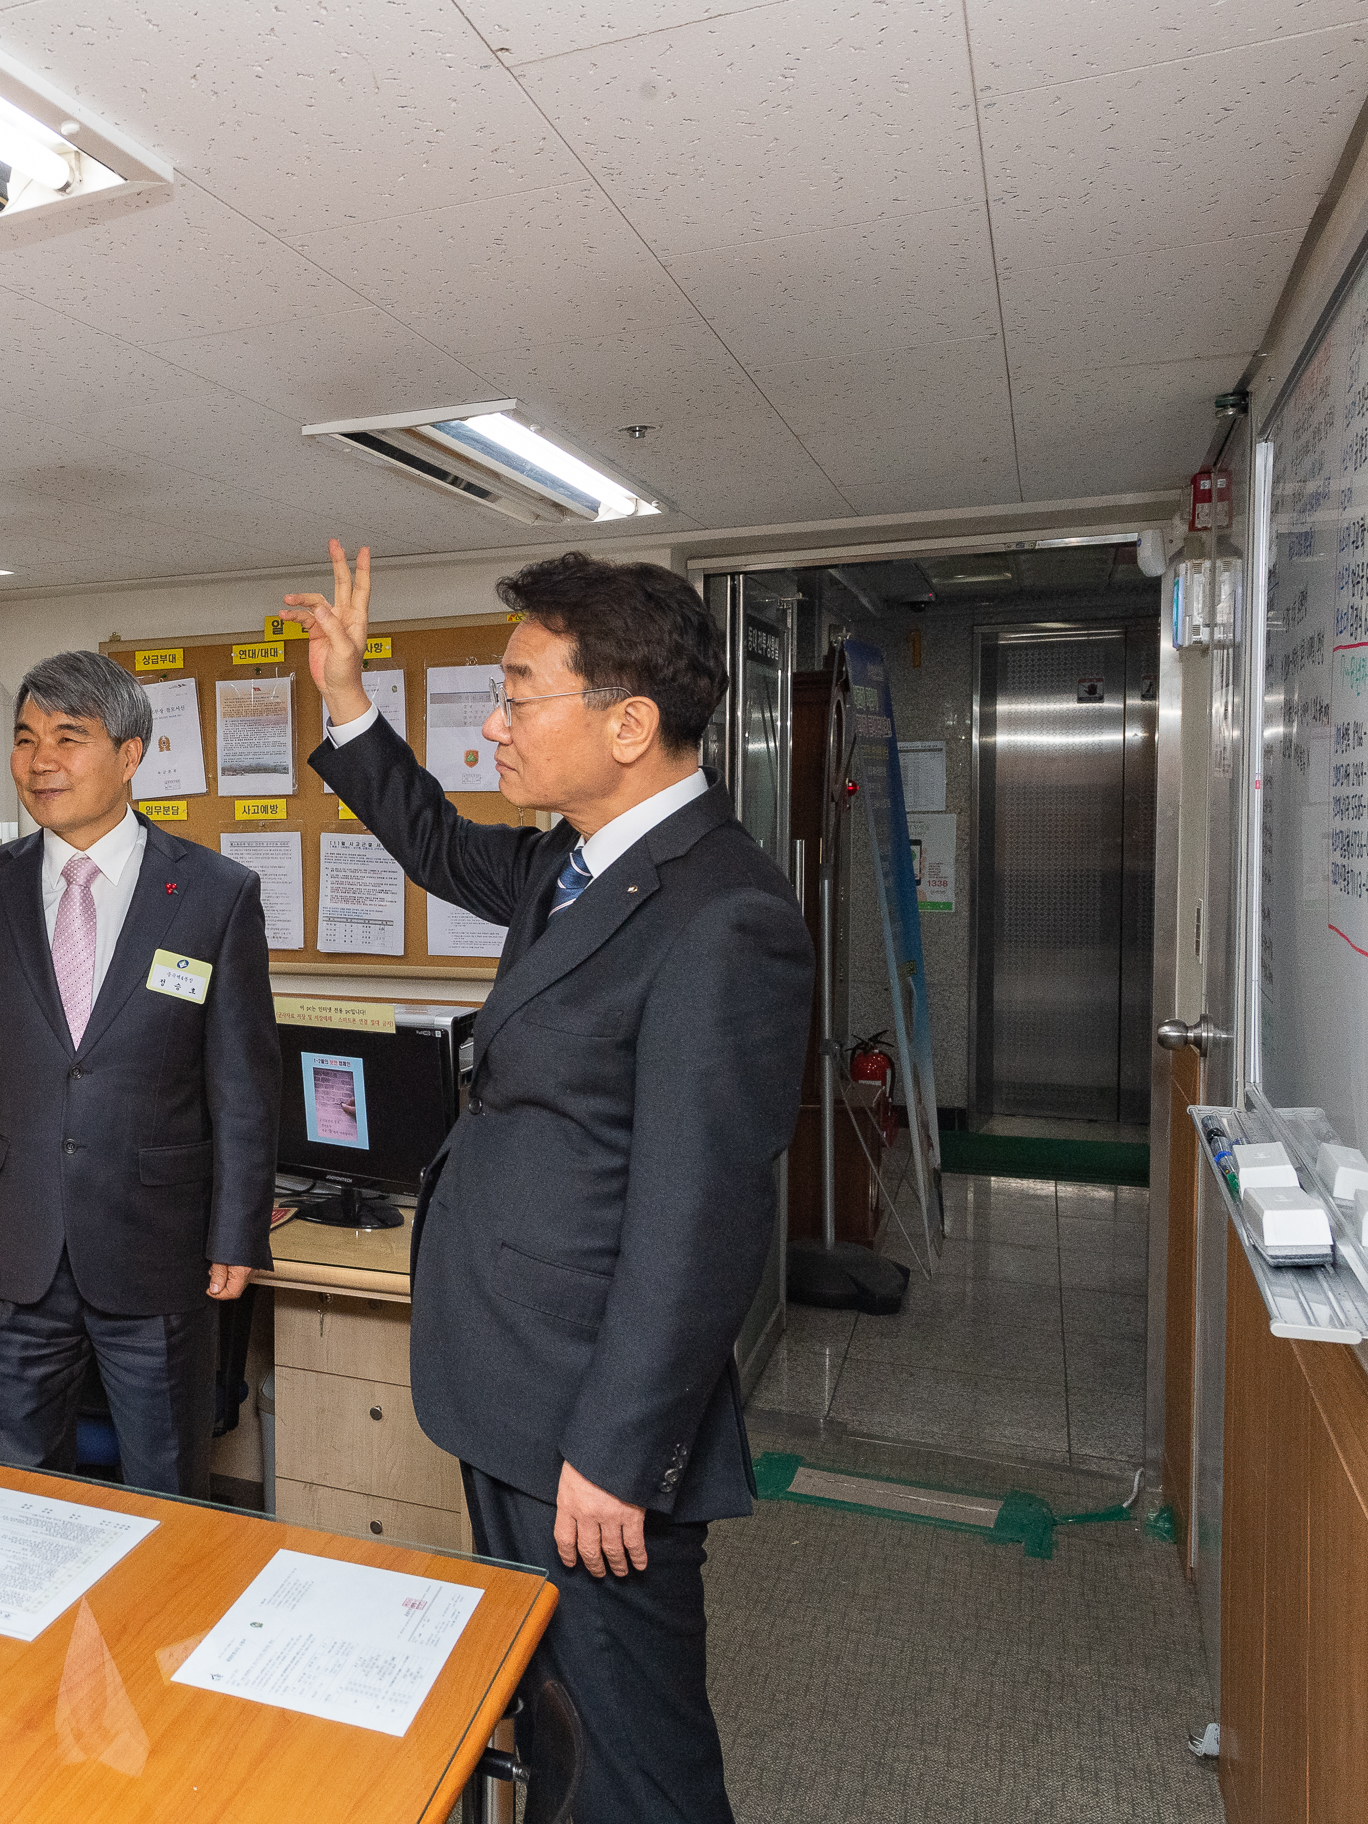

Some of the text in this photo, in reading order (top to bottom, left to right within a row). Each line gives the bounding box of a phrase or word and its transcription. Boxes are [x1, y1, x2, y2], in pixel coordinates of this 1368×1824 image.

[142, 653, 177, 666] 상급부대
[238, 647, 279, 660] 연대/대대
[145, 805, 180, 816] 임무분담
[241, 804, 279, 815] 사고예방
